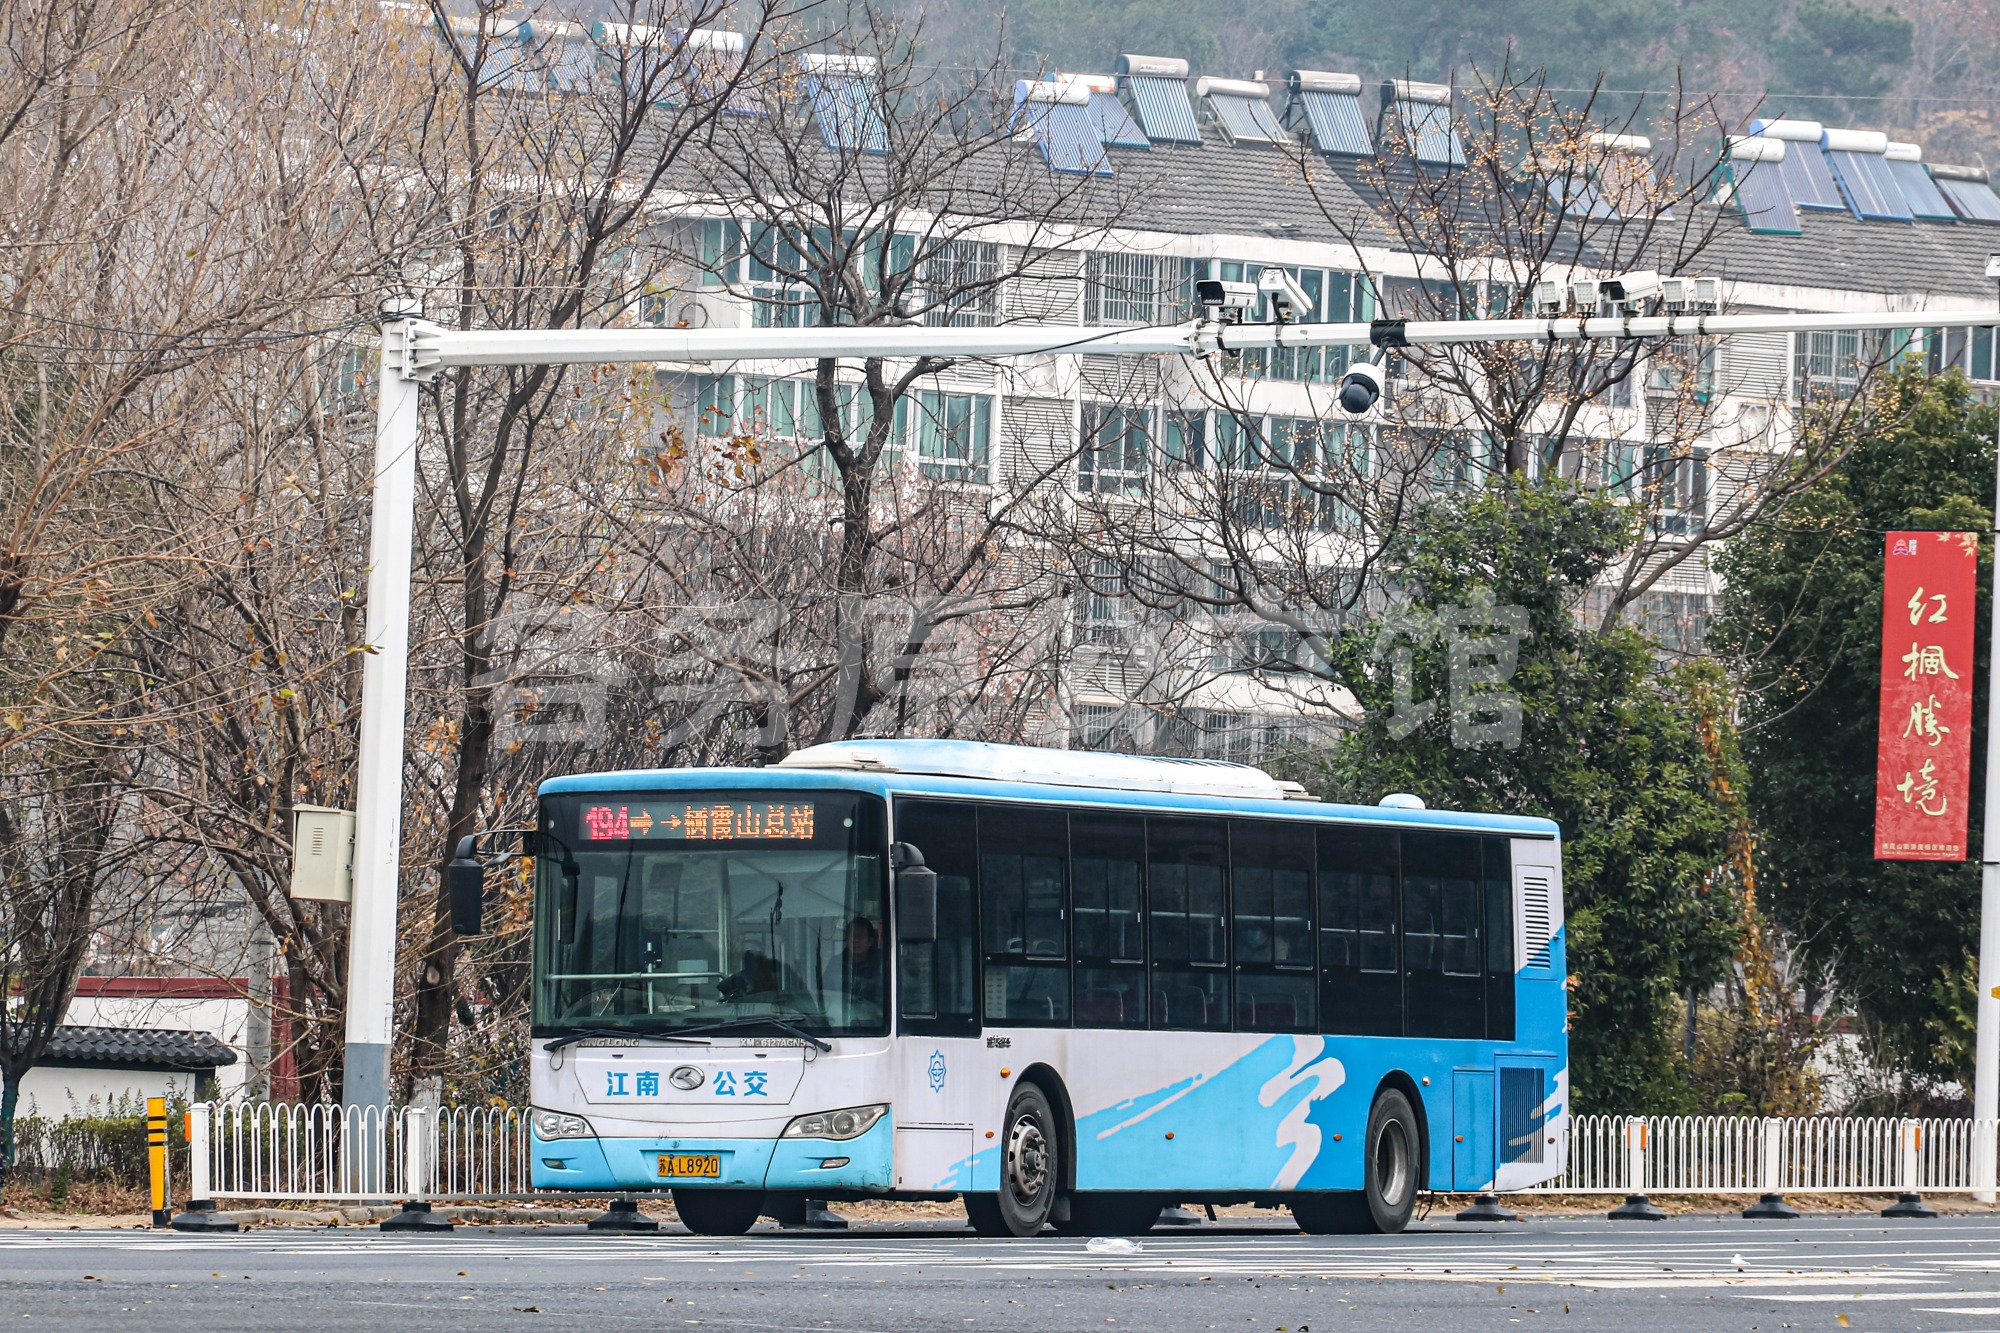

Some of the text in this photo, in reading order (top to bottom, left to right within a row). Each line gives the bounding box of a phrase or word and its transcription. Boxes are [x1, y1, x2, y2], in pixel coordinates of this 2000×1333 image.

[585, 804, 815, 840] 194 栖霞山总站
[577, 1038, 640, 1047] KING LONG
[606, 1071, 768, 1096] 江南 公交
